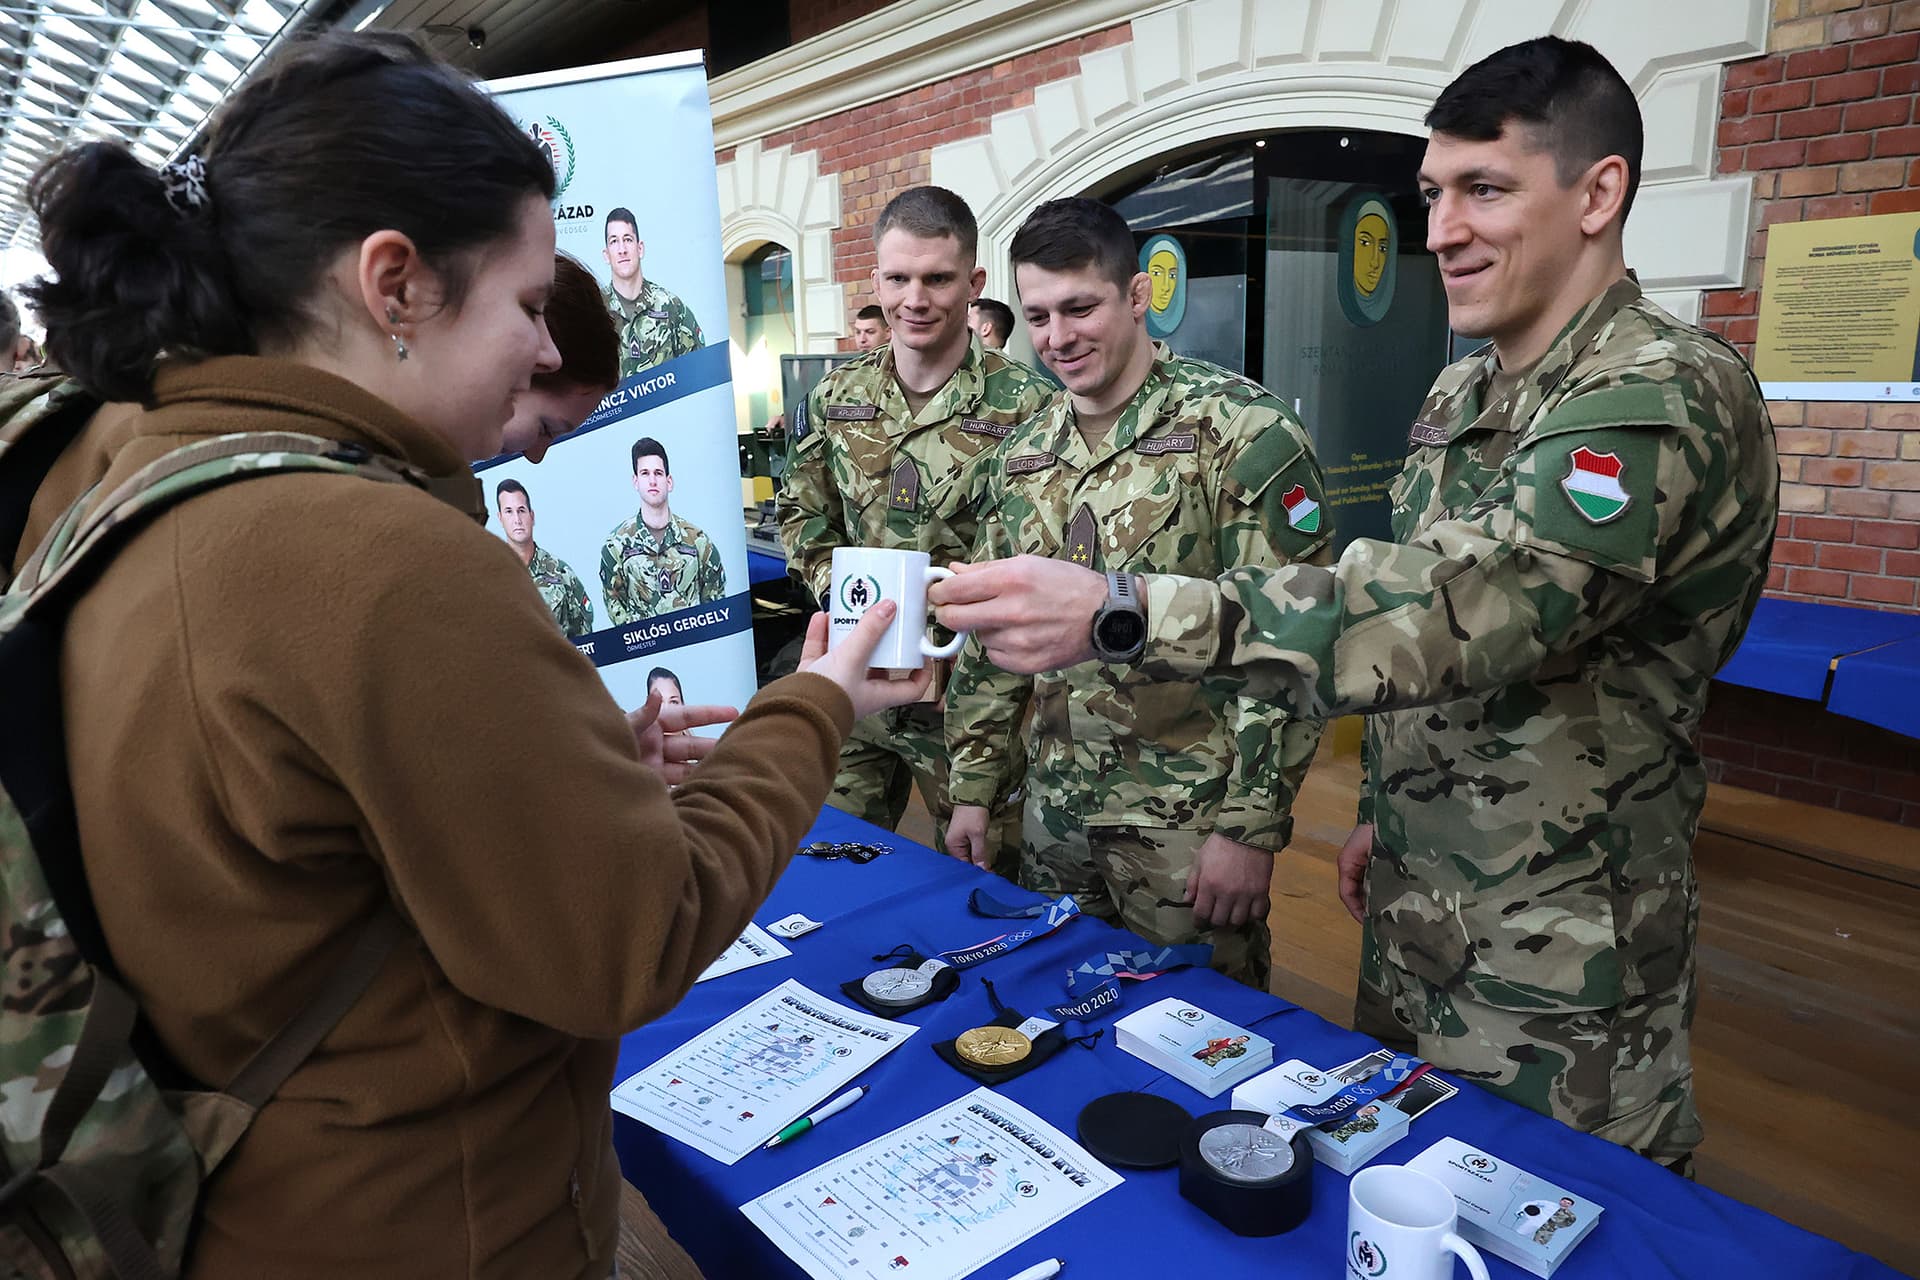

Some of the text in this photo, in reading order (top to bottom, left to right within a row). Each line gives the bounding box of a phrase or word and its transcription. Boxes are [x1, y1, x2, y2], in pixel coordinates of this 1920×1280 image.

[628, 372, 677, 400] VIKTOR
[969, 422, 1008, 435] HUNGARY
[623, 623, 672, 646] SIKLÓSI
[674, 607, 731, 632] GERGELY
[951, 942, 1008, 964] TOKYO 2020
[1055, 987, 1119, 1017] TOKYO 2020
[1329, 1094, 1358, 1112] 2020
[967, 1103, 1056, 1159] SPORTSZÁZAD
